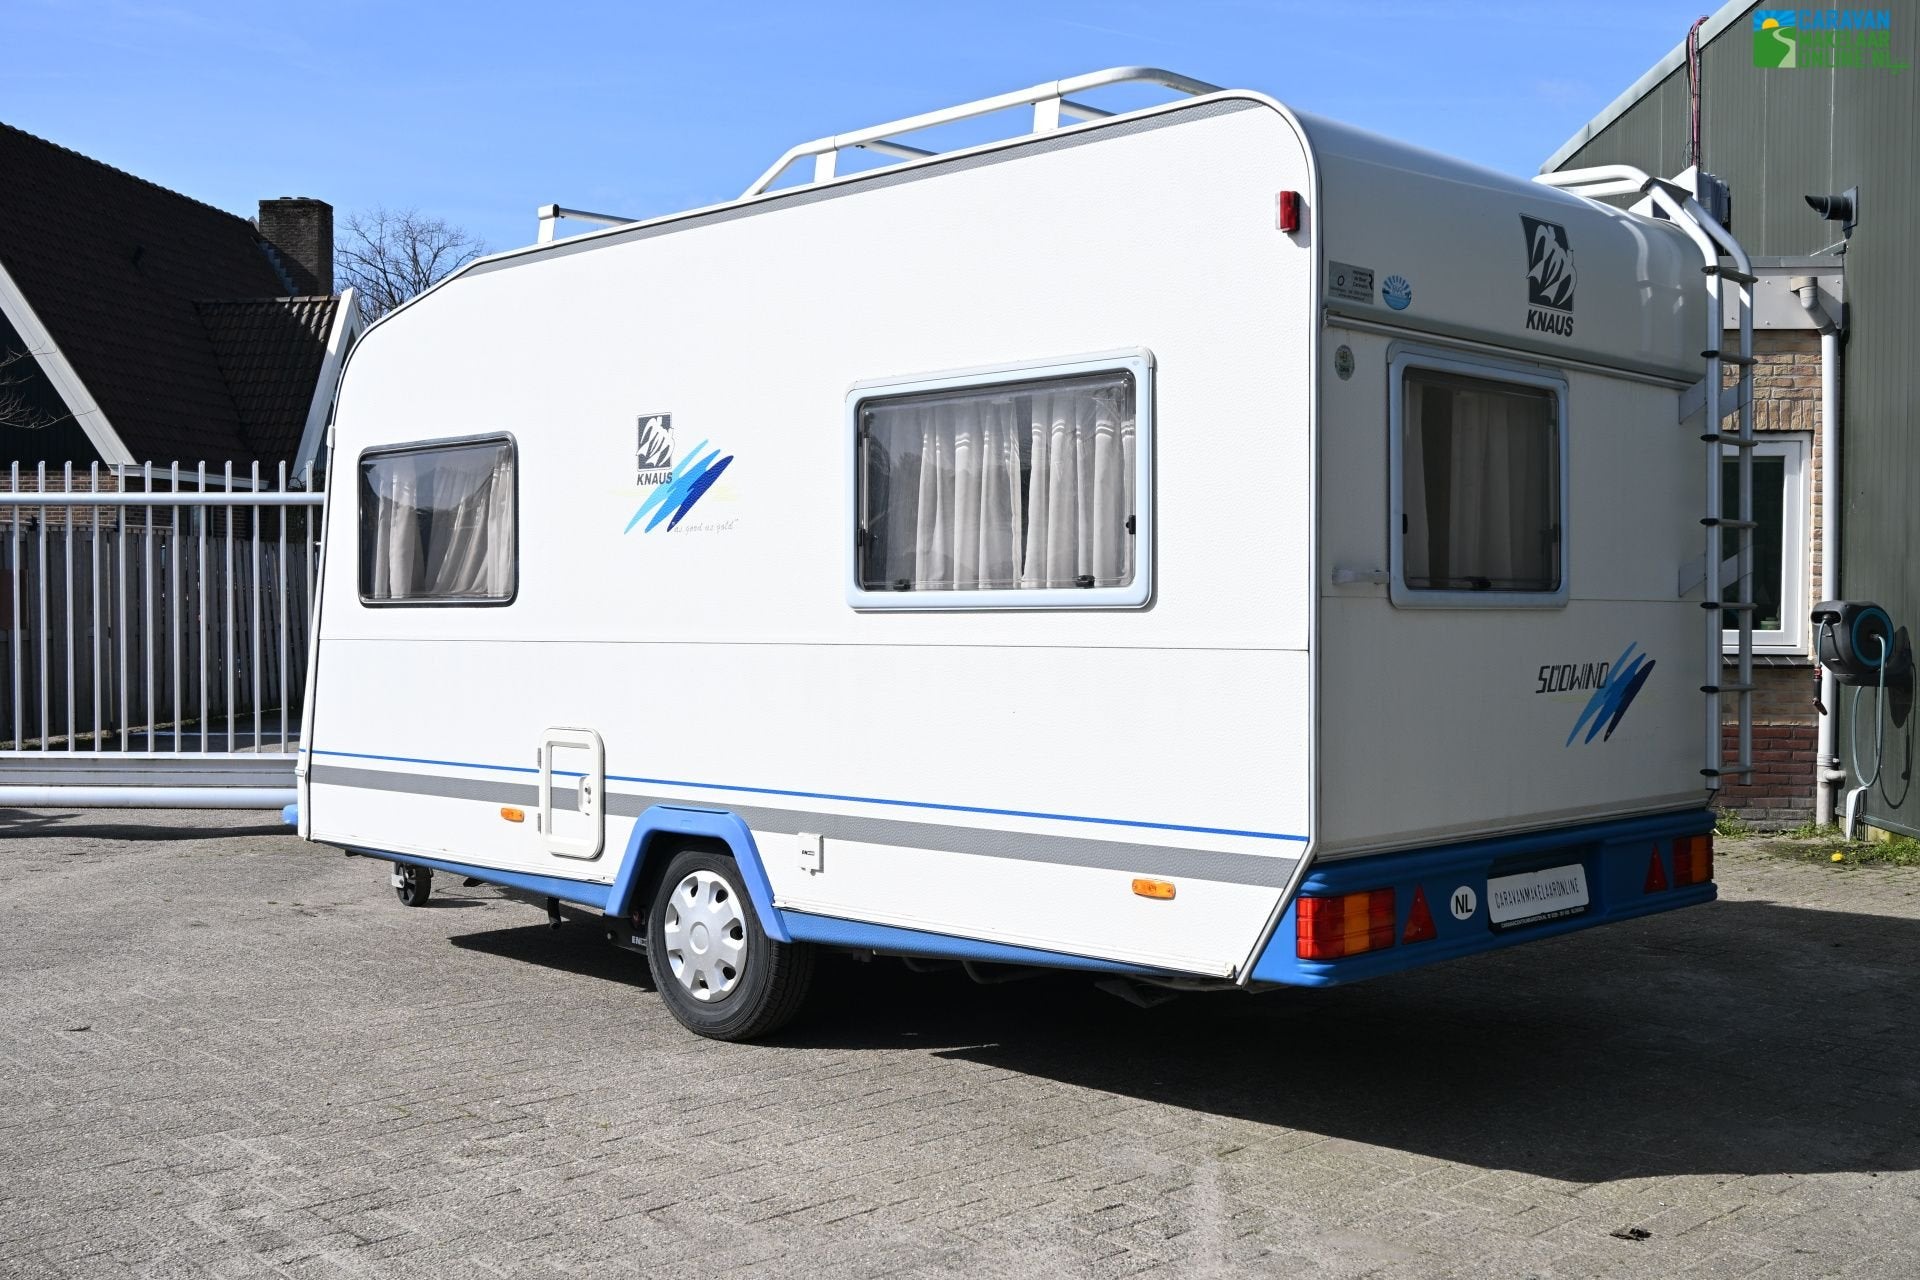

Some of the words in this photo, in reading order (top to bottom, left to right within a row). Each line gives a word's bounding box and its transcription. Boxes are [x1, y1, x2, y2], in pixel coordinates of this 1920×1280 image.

[1525, 309, 1574, 337] KNAUS
[637, 472, 673, 486] KNAUS
[1455, 894, 1472, 915] NL
[1494, 877, 1580, 909] CARAVANMAKELAARONLINE
